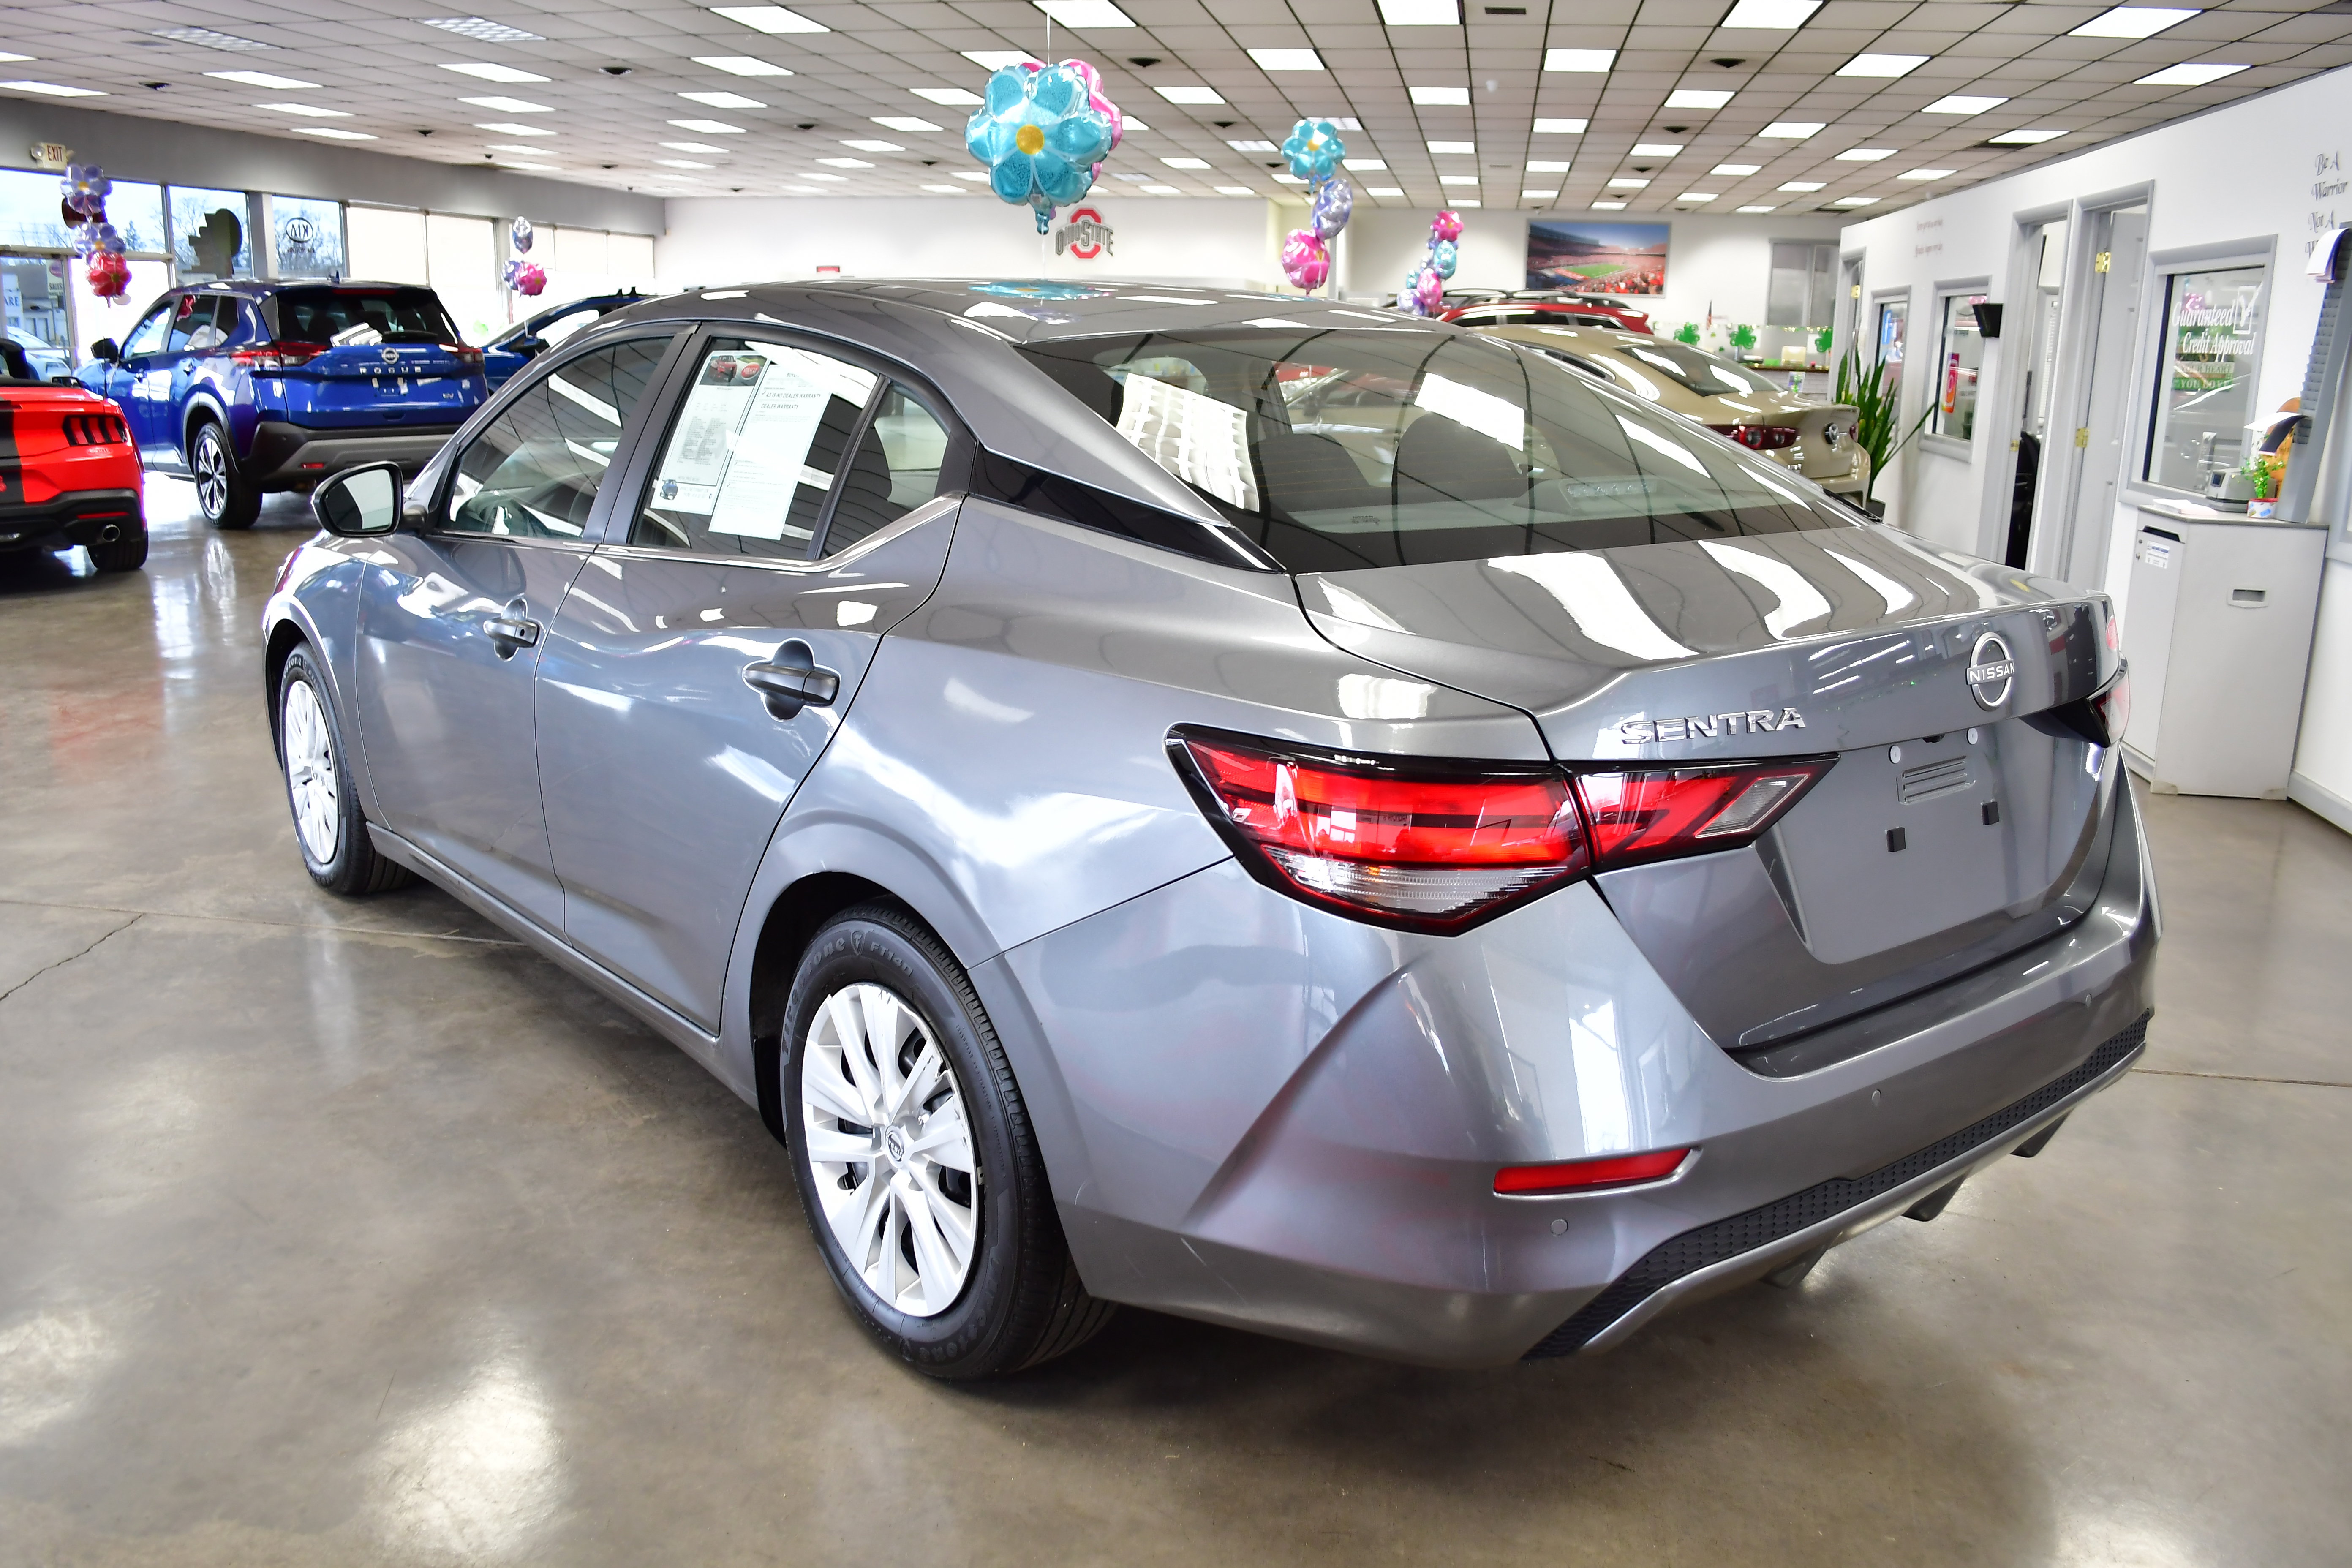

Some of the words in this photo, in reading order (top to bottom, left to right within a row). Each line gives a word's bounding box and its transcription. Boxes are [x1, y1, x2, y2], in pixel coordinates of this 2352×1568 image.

[47, 145, 63, 162] EXIT
[2314, 153, 2328, 176] Be
[2329, 150, 2340, 171] A
[2311, 178, 2348, 201] Warrior
[2308, 211, 2324, 234] Not
[2324, 209, 2335, 230] A
[1056, 223, 1081, 256] OHIO
[1081, 219, 1114, 256] STATE
[2172, 299, 2236, 327] Guaranteed
[2182, 328, 2211, 354] Credit
[2209, 332, 2257, 362] Approval
[359, 366, 422, 375] ROGUE
[2181, 379, 2200, 389] YOU
[1969, 662, 2015, 683] NISSAN
[1620, 707, 1806, 745] SENTRA
